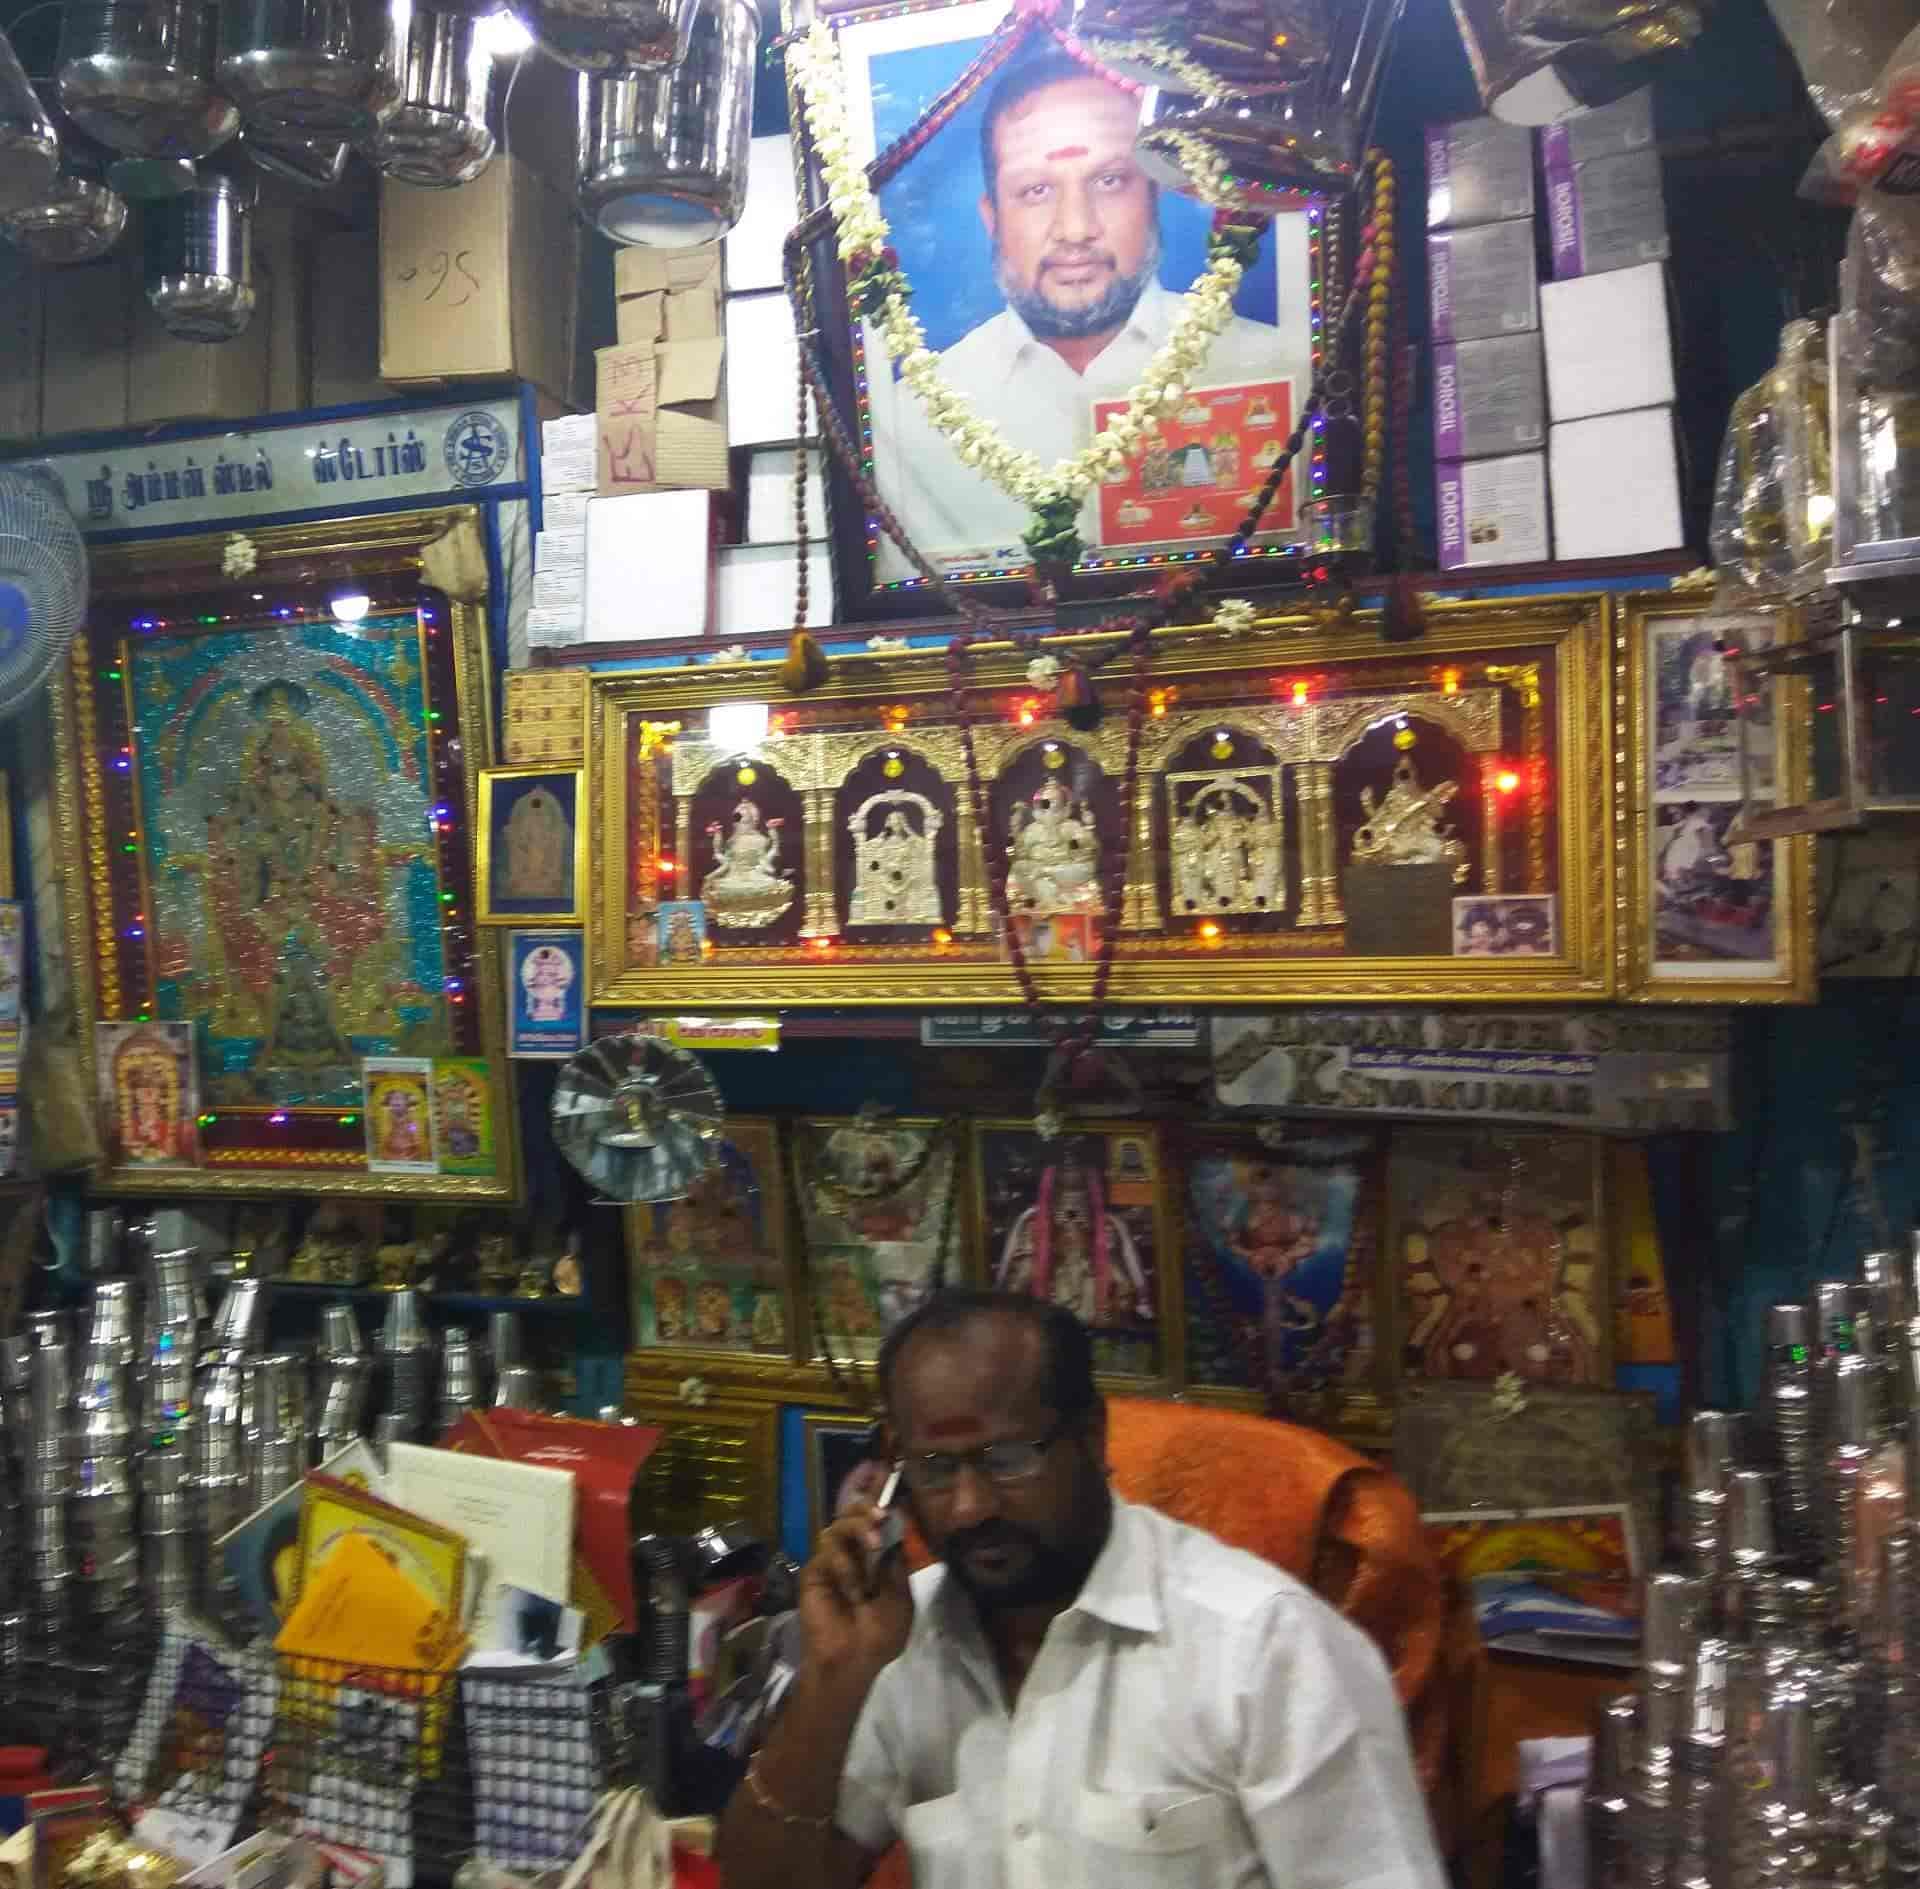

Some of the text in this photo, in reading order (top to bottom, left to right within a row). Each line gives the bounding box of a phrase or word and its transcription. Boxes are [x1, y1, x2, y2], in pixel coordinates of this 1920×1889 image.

[1551, 181, 1577, 252] BOROSIL
[1438, 364, 1457, 434] BOROSIL
[1440, 480, 1461, 551] BOROSIL
